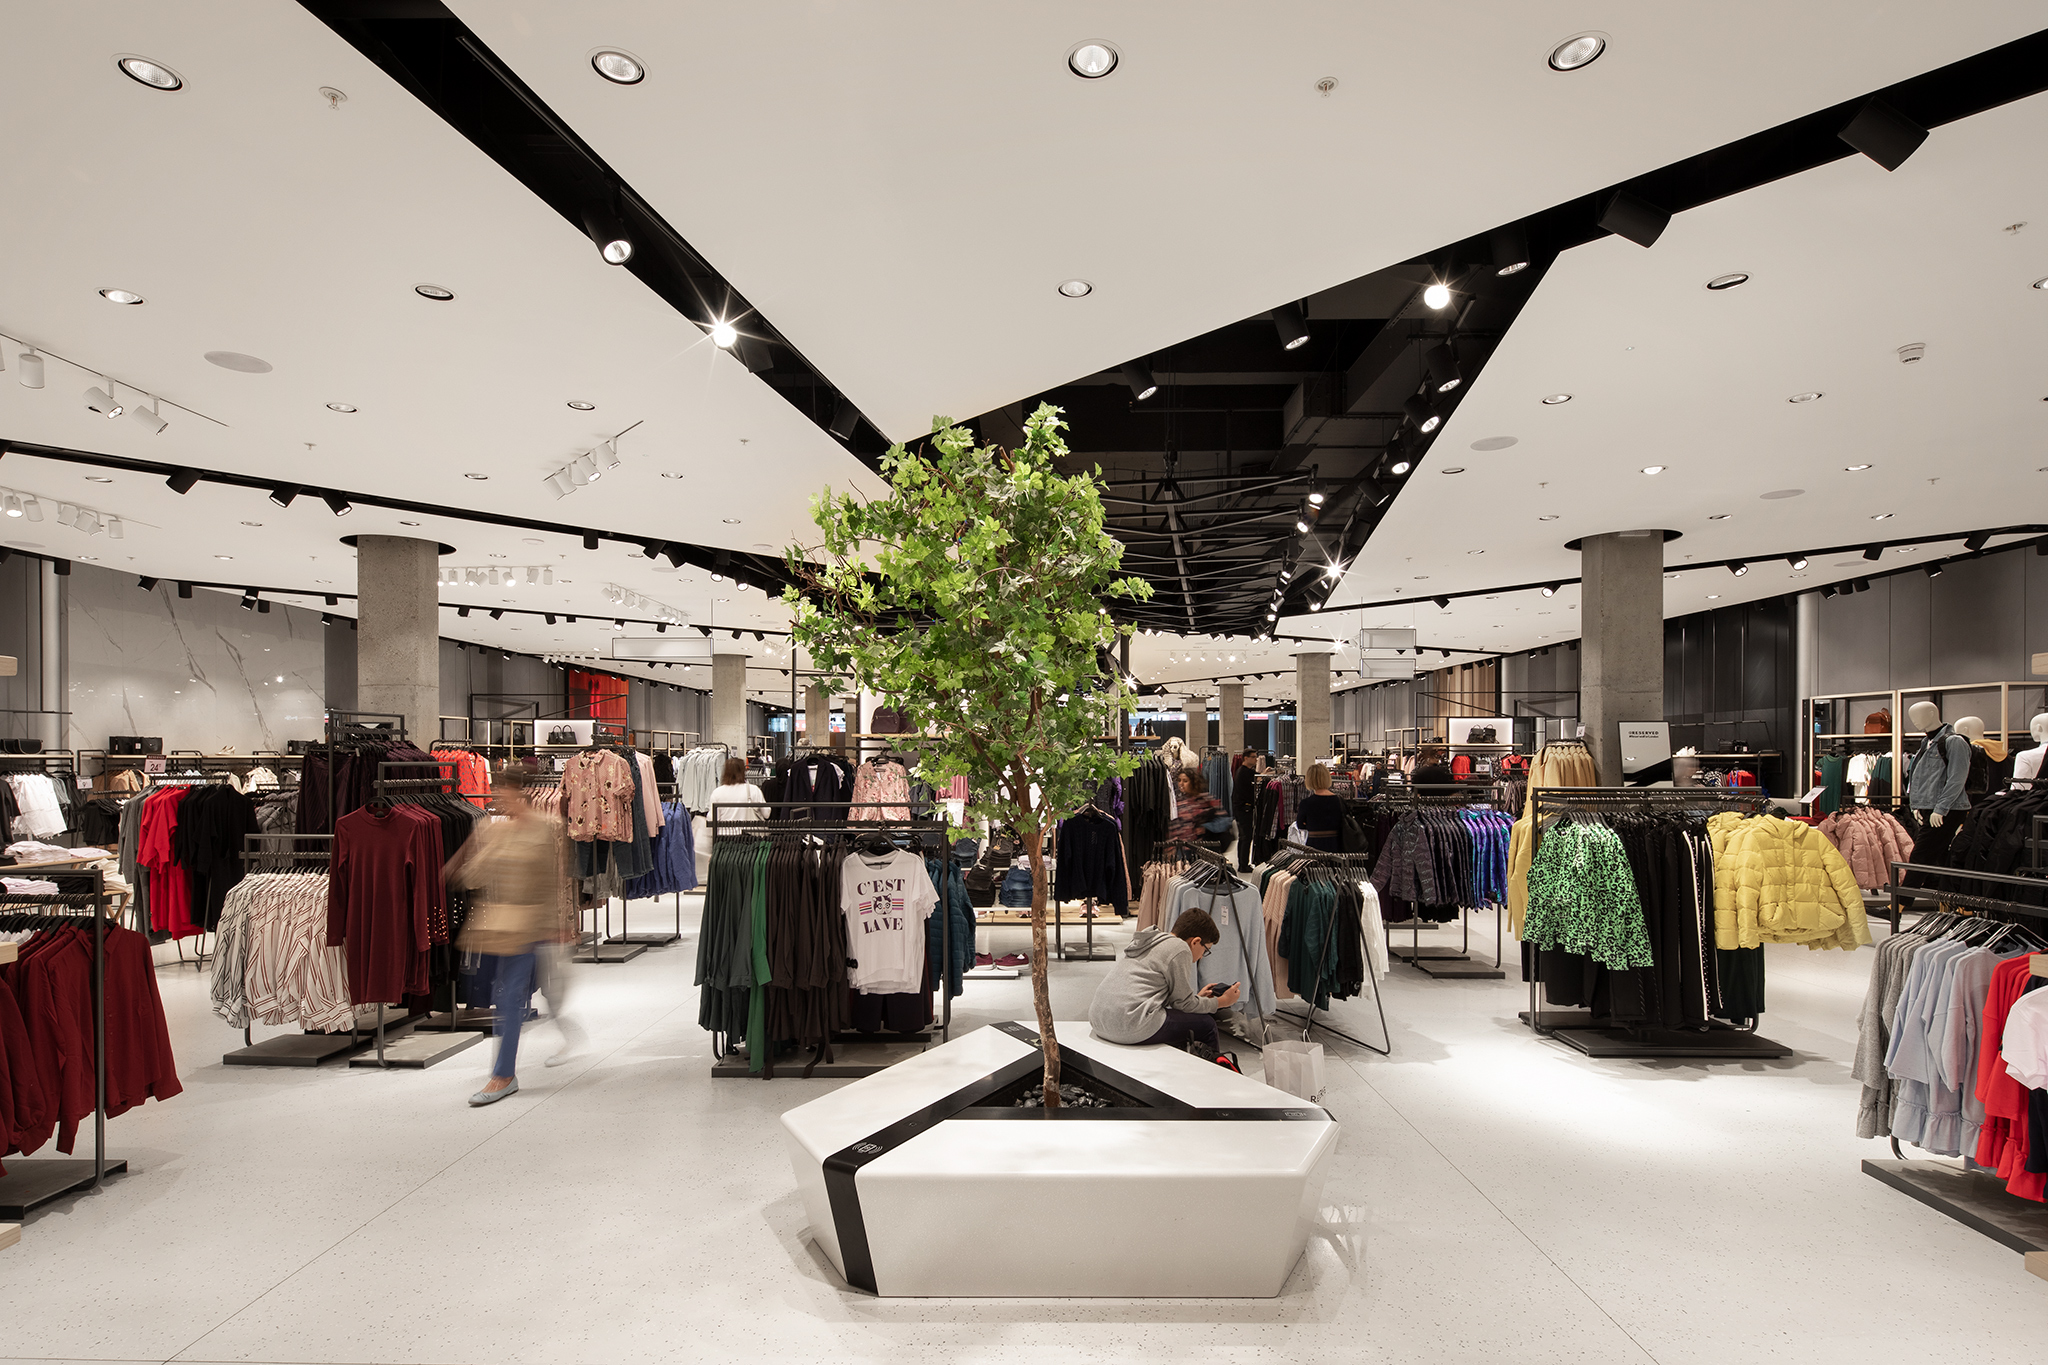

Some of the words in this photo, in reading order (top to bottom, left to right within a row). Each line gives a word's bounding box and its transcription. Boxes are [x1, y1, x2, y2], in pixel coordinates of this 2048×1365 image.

[150, 763, 159, 771] 24
[857, 878, 906, 896] C'EST
[863, 918, 881, 934] LA
